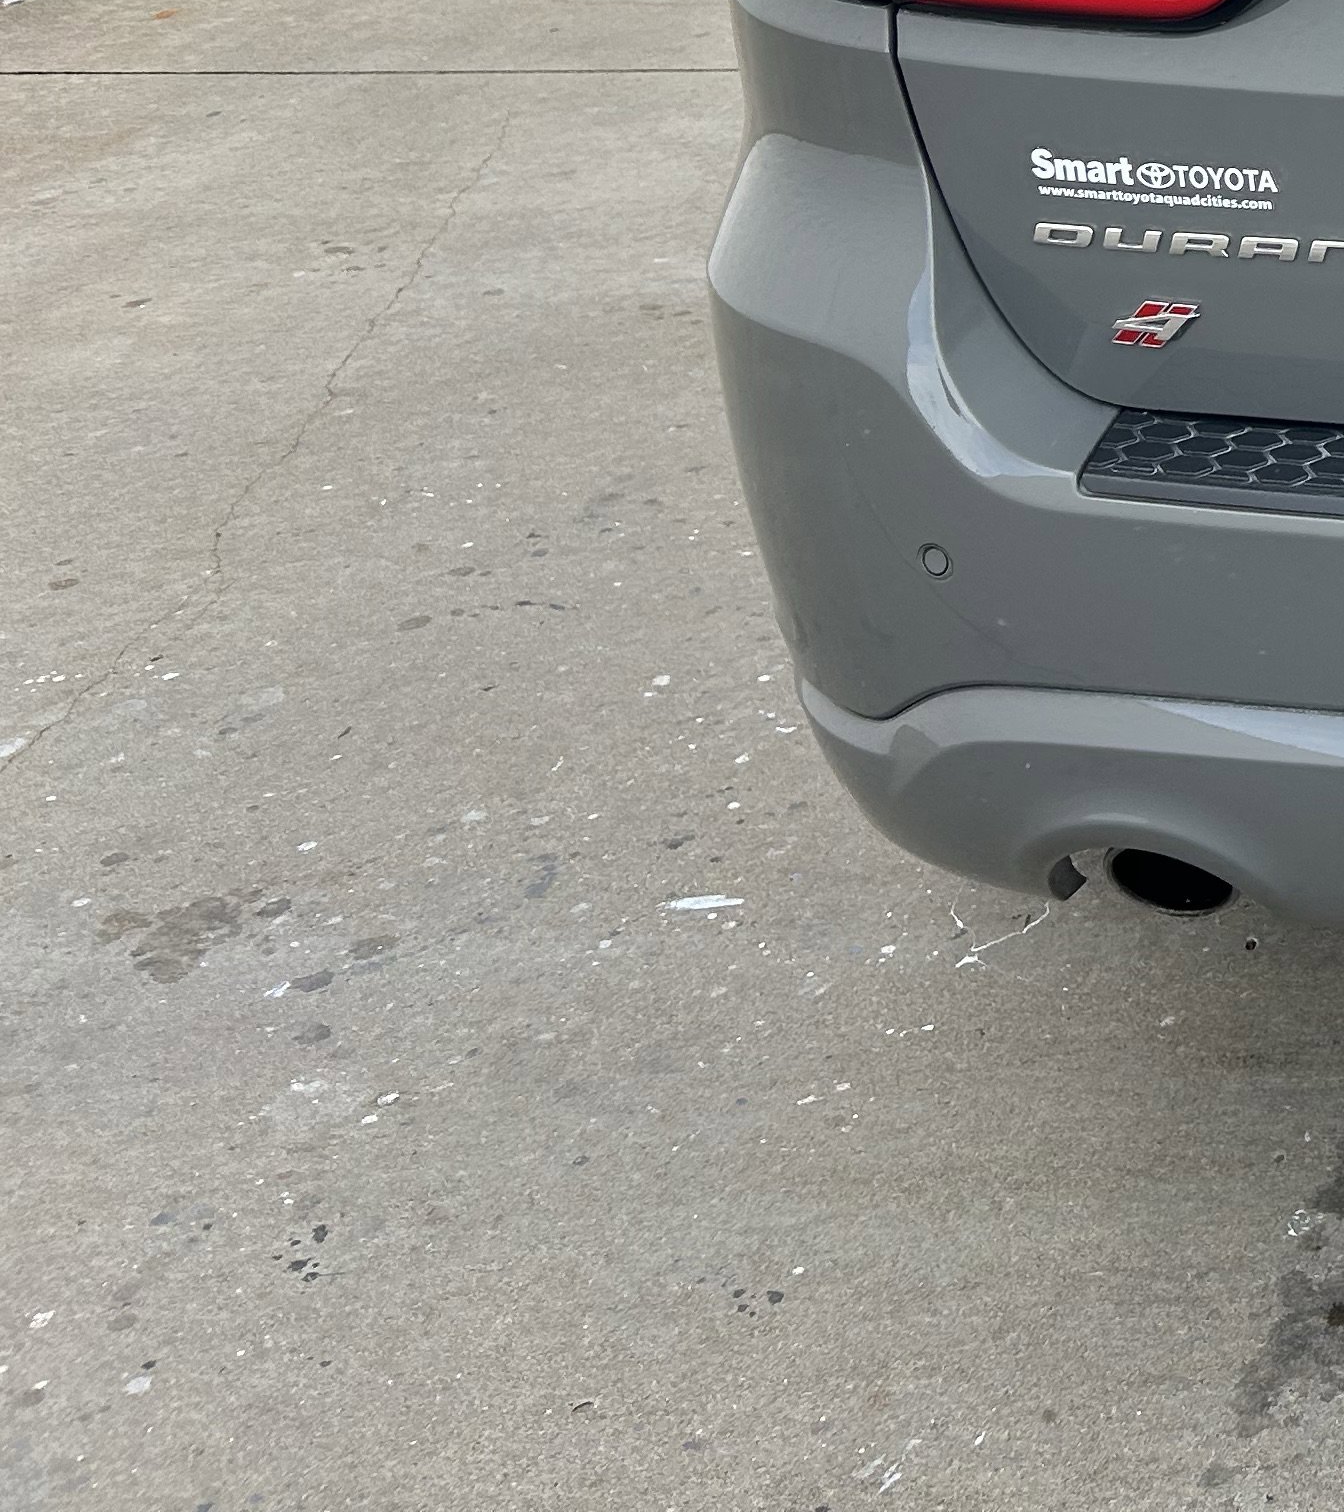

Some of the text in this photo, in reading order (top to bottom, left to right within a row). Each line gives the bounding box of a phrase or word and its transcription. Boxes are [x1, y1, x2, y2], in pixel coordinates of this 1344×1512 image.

[1030, 147, 1279, 193] Smart TOYOTA
[1037, 185, 1274, 210] www.smarttoyotaquadcities.com
